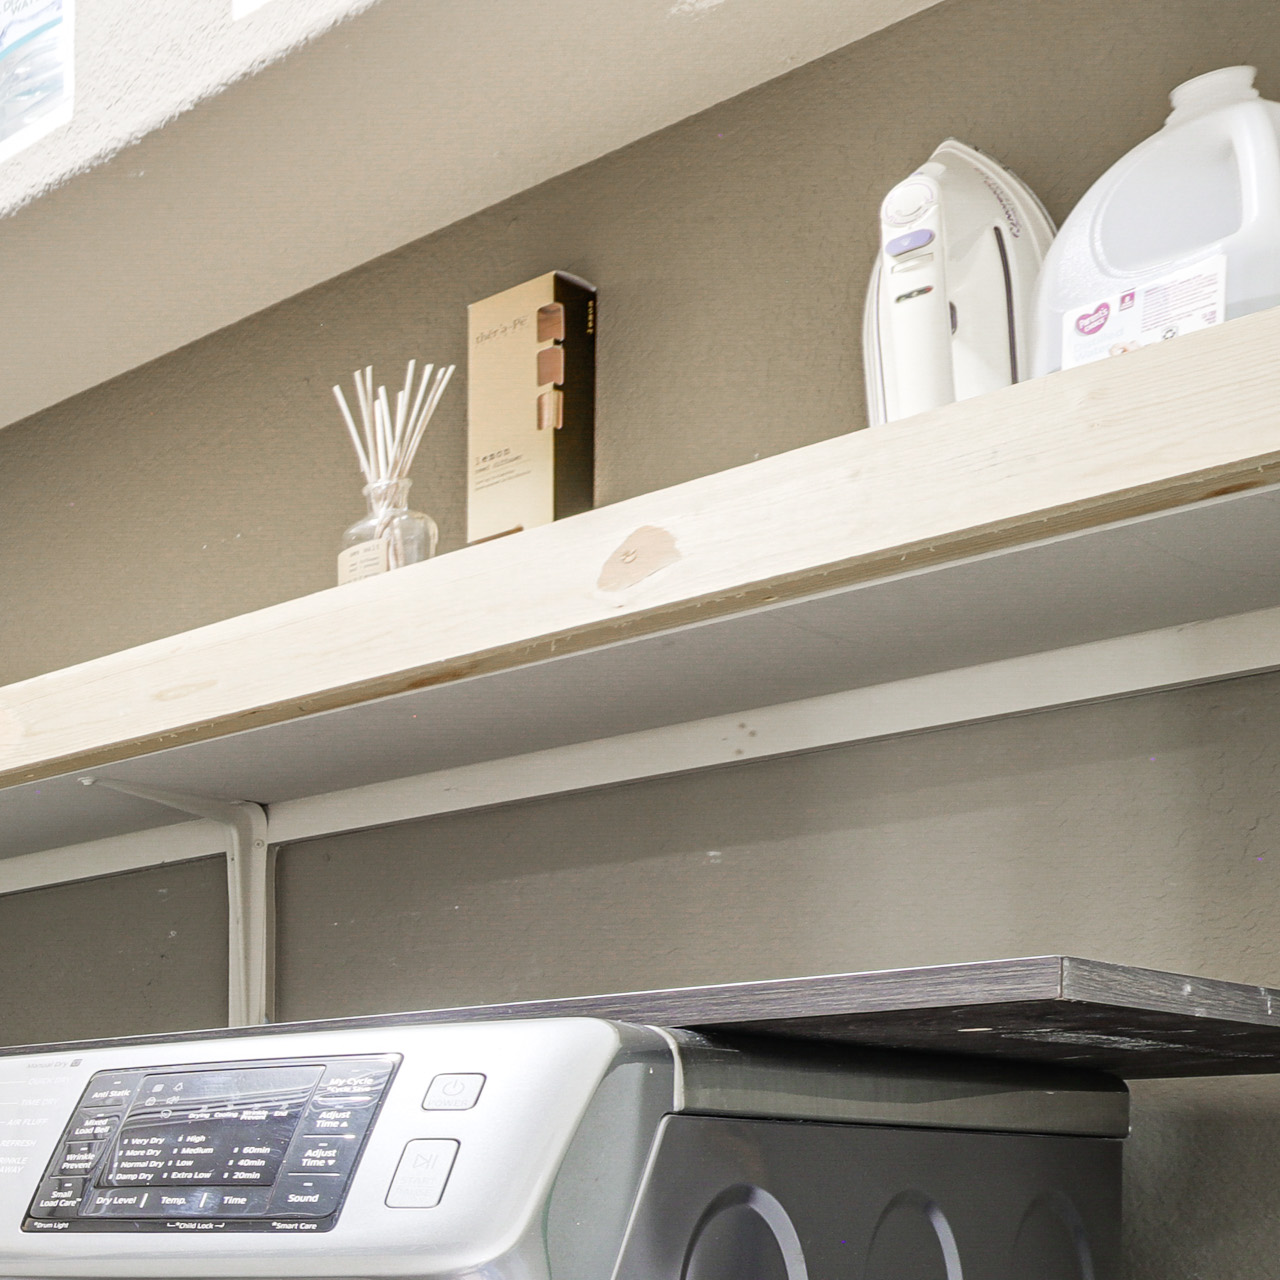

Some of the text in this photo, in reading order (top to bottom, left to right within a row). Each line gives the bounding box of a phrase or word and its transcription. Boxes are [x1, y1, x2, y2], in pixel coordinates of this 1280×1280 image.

[329, 1077, 374, 1086] My Cycle
[109, 1089, 131, 1098] Static
[318, 1111, 351, 1119] Adjust
[316, 1120, 340, 1128] Time
[74, 1127, 94, 1135] Load
[149, 1137, 166, 1145] Dry
[185, 1135, 206, 1143] High
[0, 1140, 37, 1148] REFRESH
[66, 1153, 96, 1161] Wrinkle
[304, 1149, 337, 1158] Adjust
[61, 1161, 91, 1169] Prevent
[120, 1160, 165, 1168] Normal Dry
[301, 1158, 326, 1167] Time
[115, 1172, 154, 1181] Damp Dry
[51, 1190, 73, 1198] Small
[95, 1196, 137, 1206] Dry Level
[161, 1196, 187, 1205] Temp.
[223, 1196, 247, 1205] Time
[287, 1194, 320, 1203] Sound
[39, 1199, 58, 1207] Load
[53, 1222, 70, 1230] Light
[299, 1222, 318, 1230] Care
